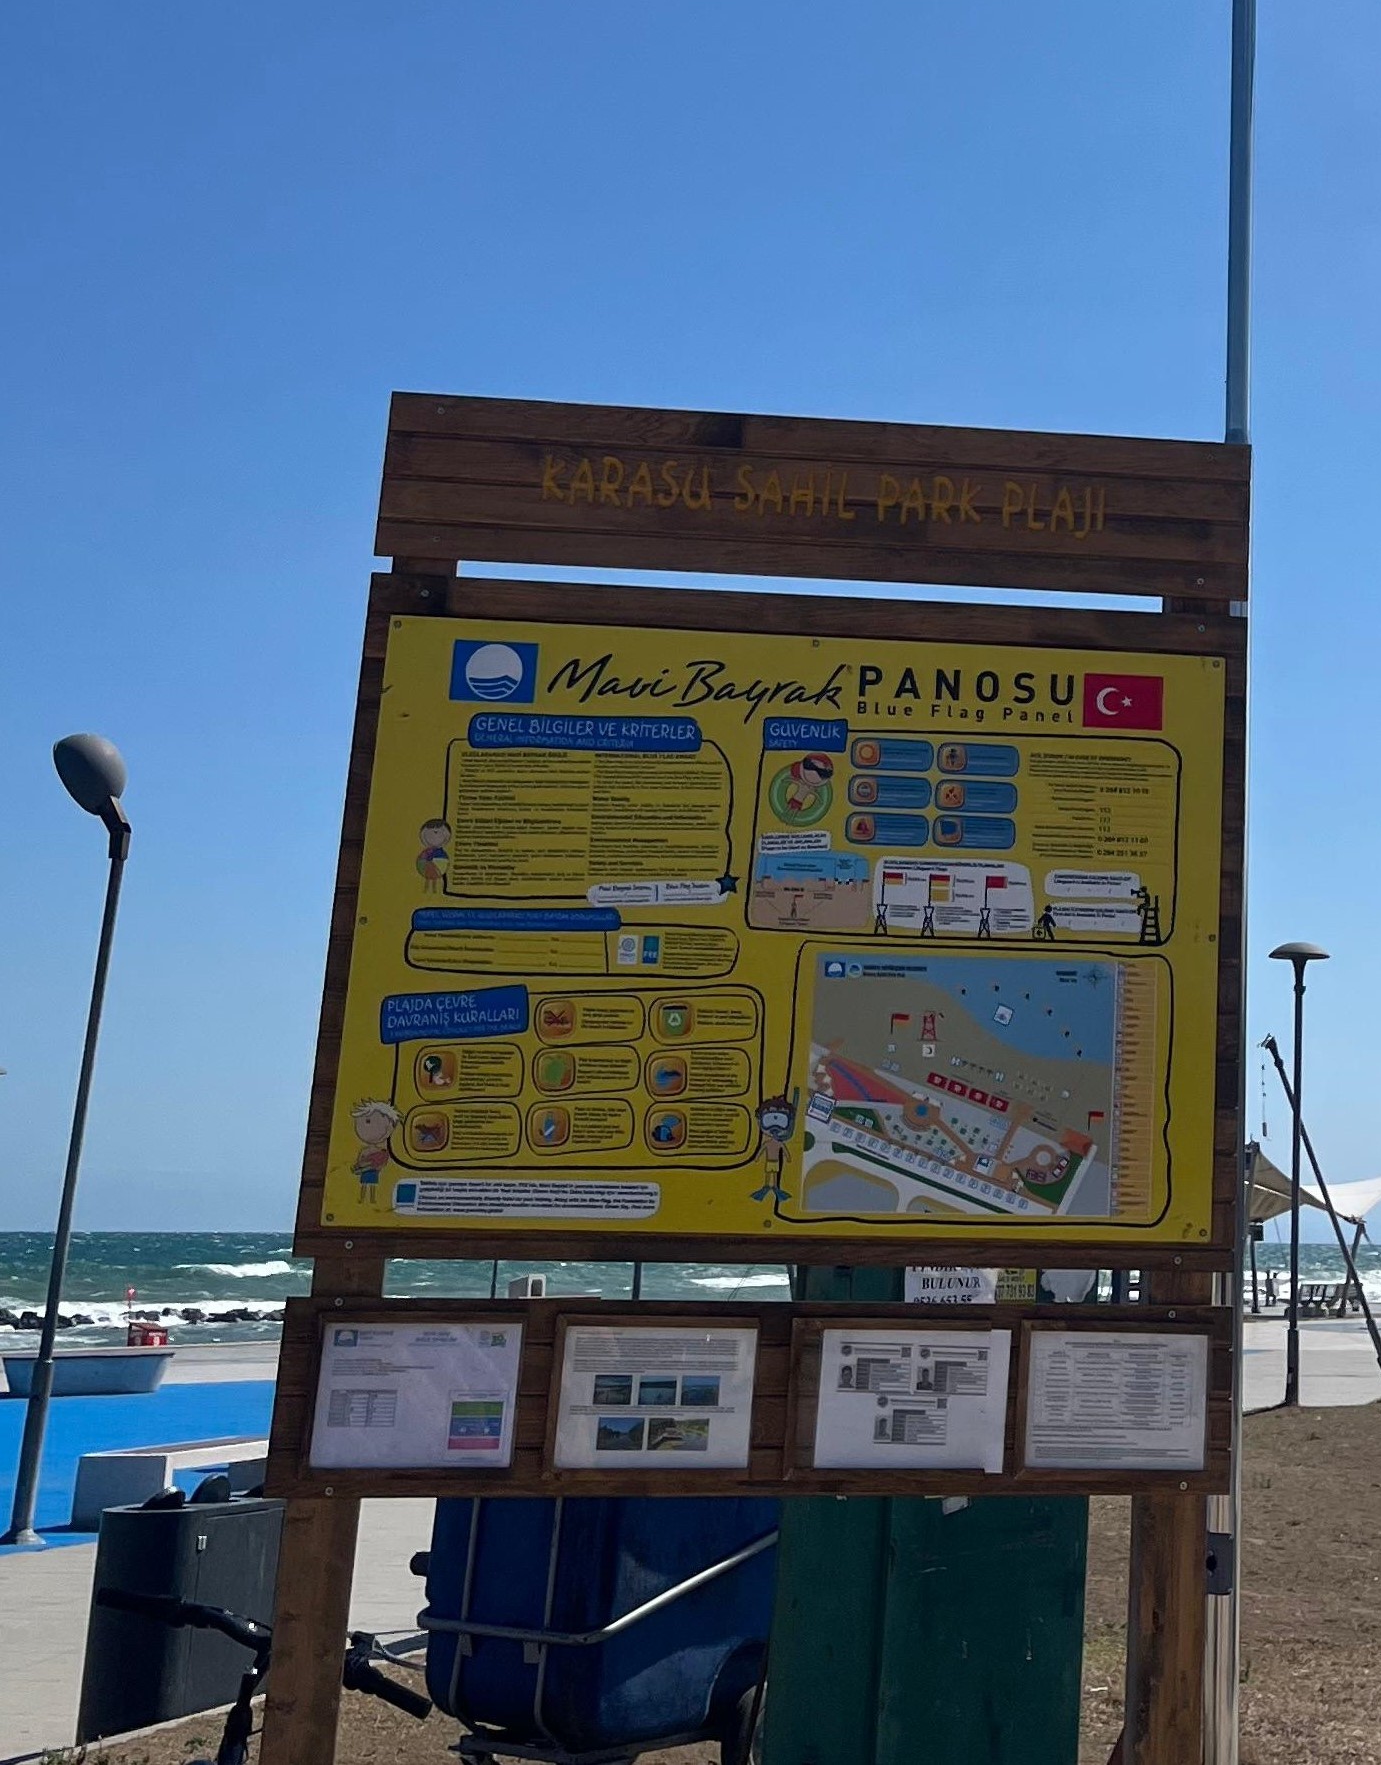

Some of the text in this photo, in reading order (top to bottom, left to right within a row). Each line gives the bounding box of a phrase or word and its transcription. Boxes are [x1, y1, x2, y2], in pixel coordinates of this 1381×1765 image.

[541, 454, 1105, 540] KARASU SAHİL PARK PLAJI
[547, 654, 1076, 723] Mavi Bayrak PANOSU
[857, 701, 1075, 724] Blue Flag Panel
[475, 716, 697, 741] GENEL BİLGİLER VE KRİTERLER
[387, 994, 477, 1014] PLAJDA ÇEVRE
[453, 1007, 520, 1024] KURALLARI
[921, 1277, 981, 1290] BULUNUR
